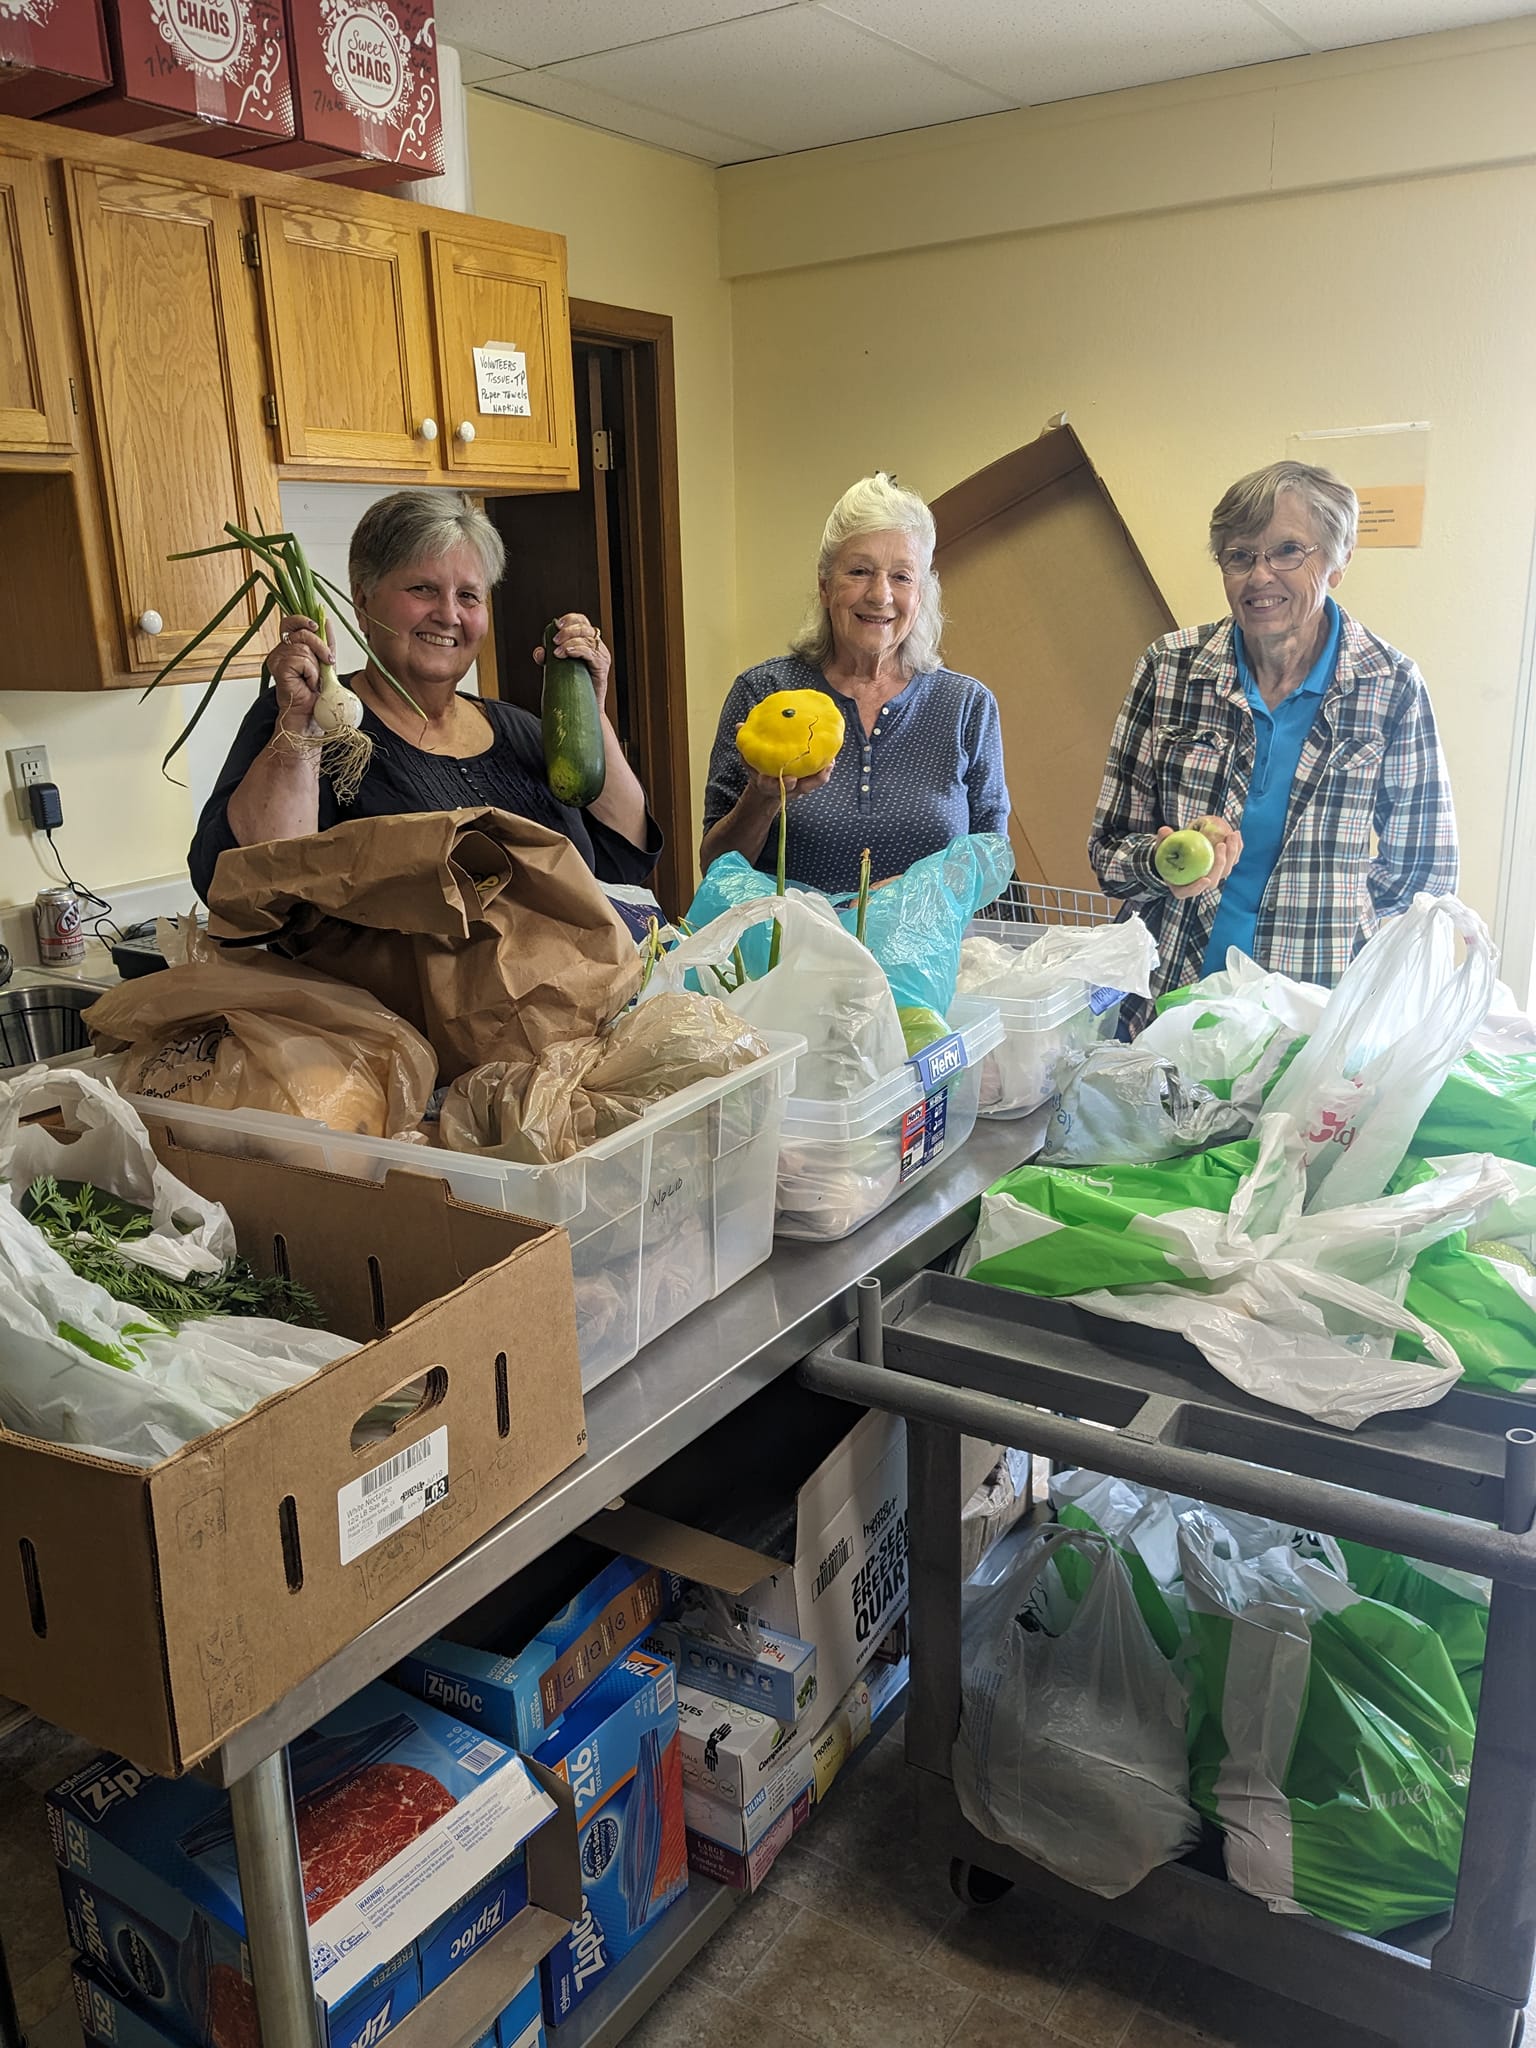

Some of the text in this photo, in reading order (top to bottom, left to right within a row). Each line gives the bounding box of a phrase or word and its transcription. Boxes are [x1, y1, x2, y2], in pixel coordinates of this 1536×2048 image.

[177, 0, 231, 39] CHAOS
[347, 29, 388, 58] Sweet
[347, 51, 392, 86] CHAOS
[931, 1046, 959, 1078] Hefty
[346, 1502, 364, 1519] White
[365, 1486, 393, 1505] Nectarine
[856, 1549, 908, 1643] QUAR
[425, 1673, 483, 1713] Ziploc
[503, 1672, 519, 1685] 38
[571, 1746, 597, 1809] 216
[747, 1788, 765, 1814] ULINE
[66, 1820, 87, 1869] 152
[358, 1884, 385, 1910] WARNING!
[450, 1900, 501, 1960] Ziploc
[372, 1946, 414, 1988] FREEZER
